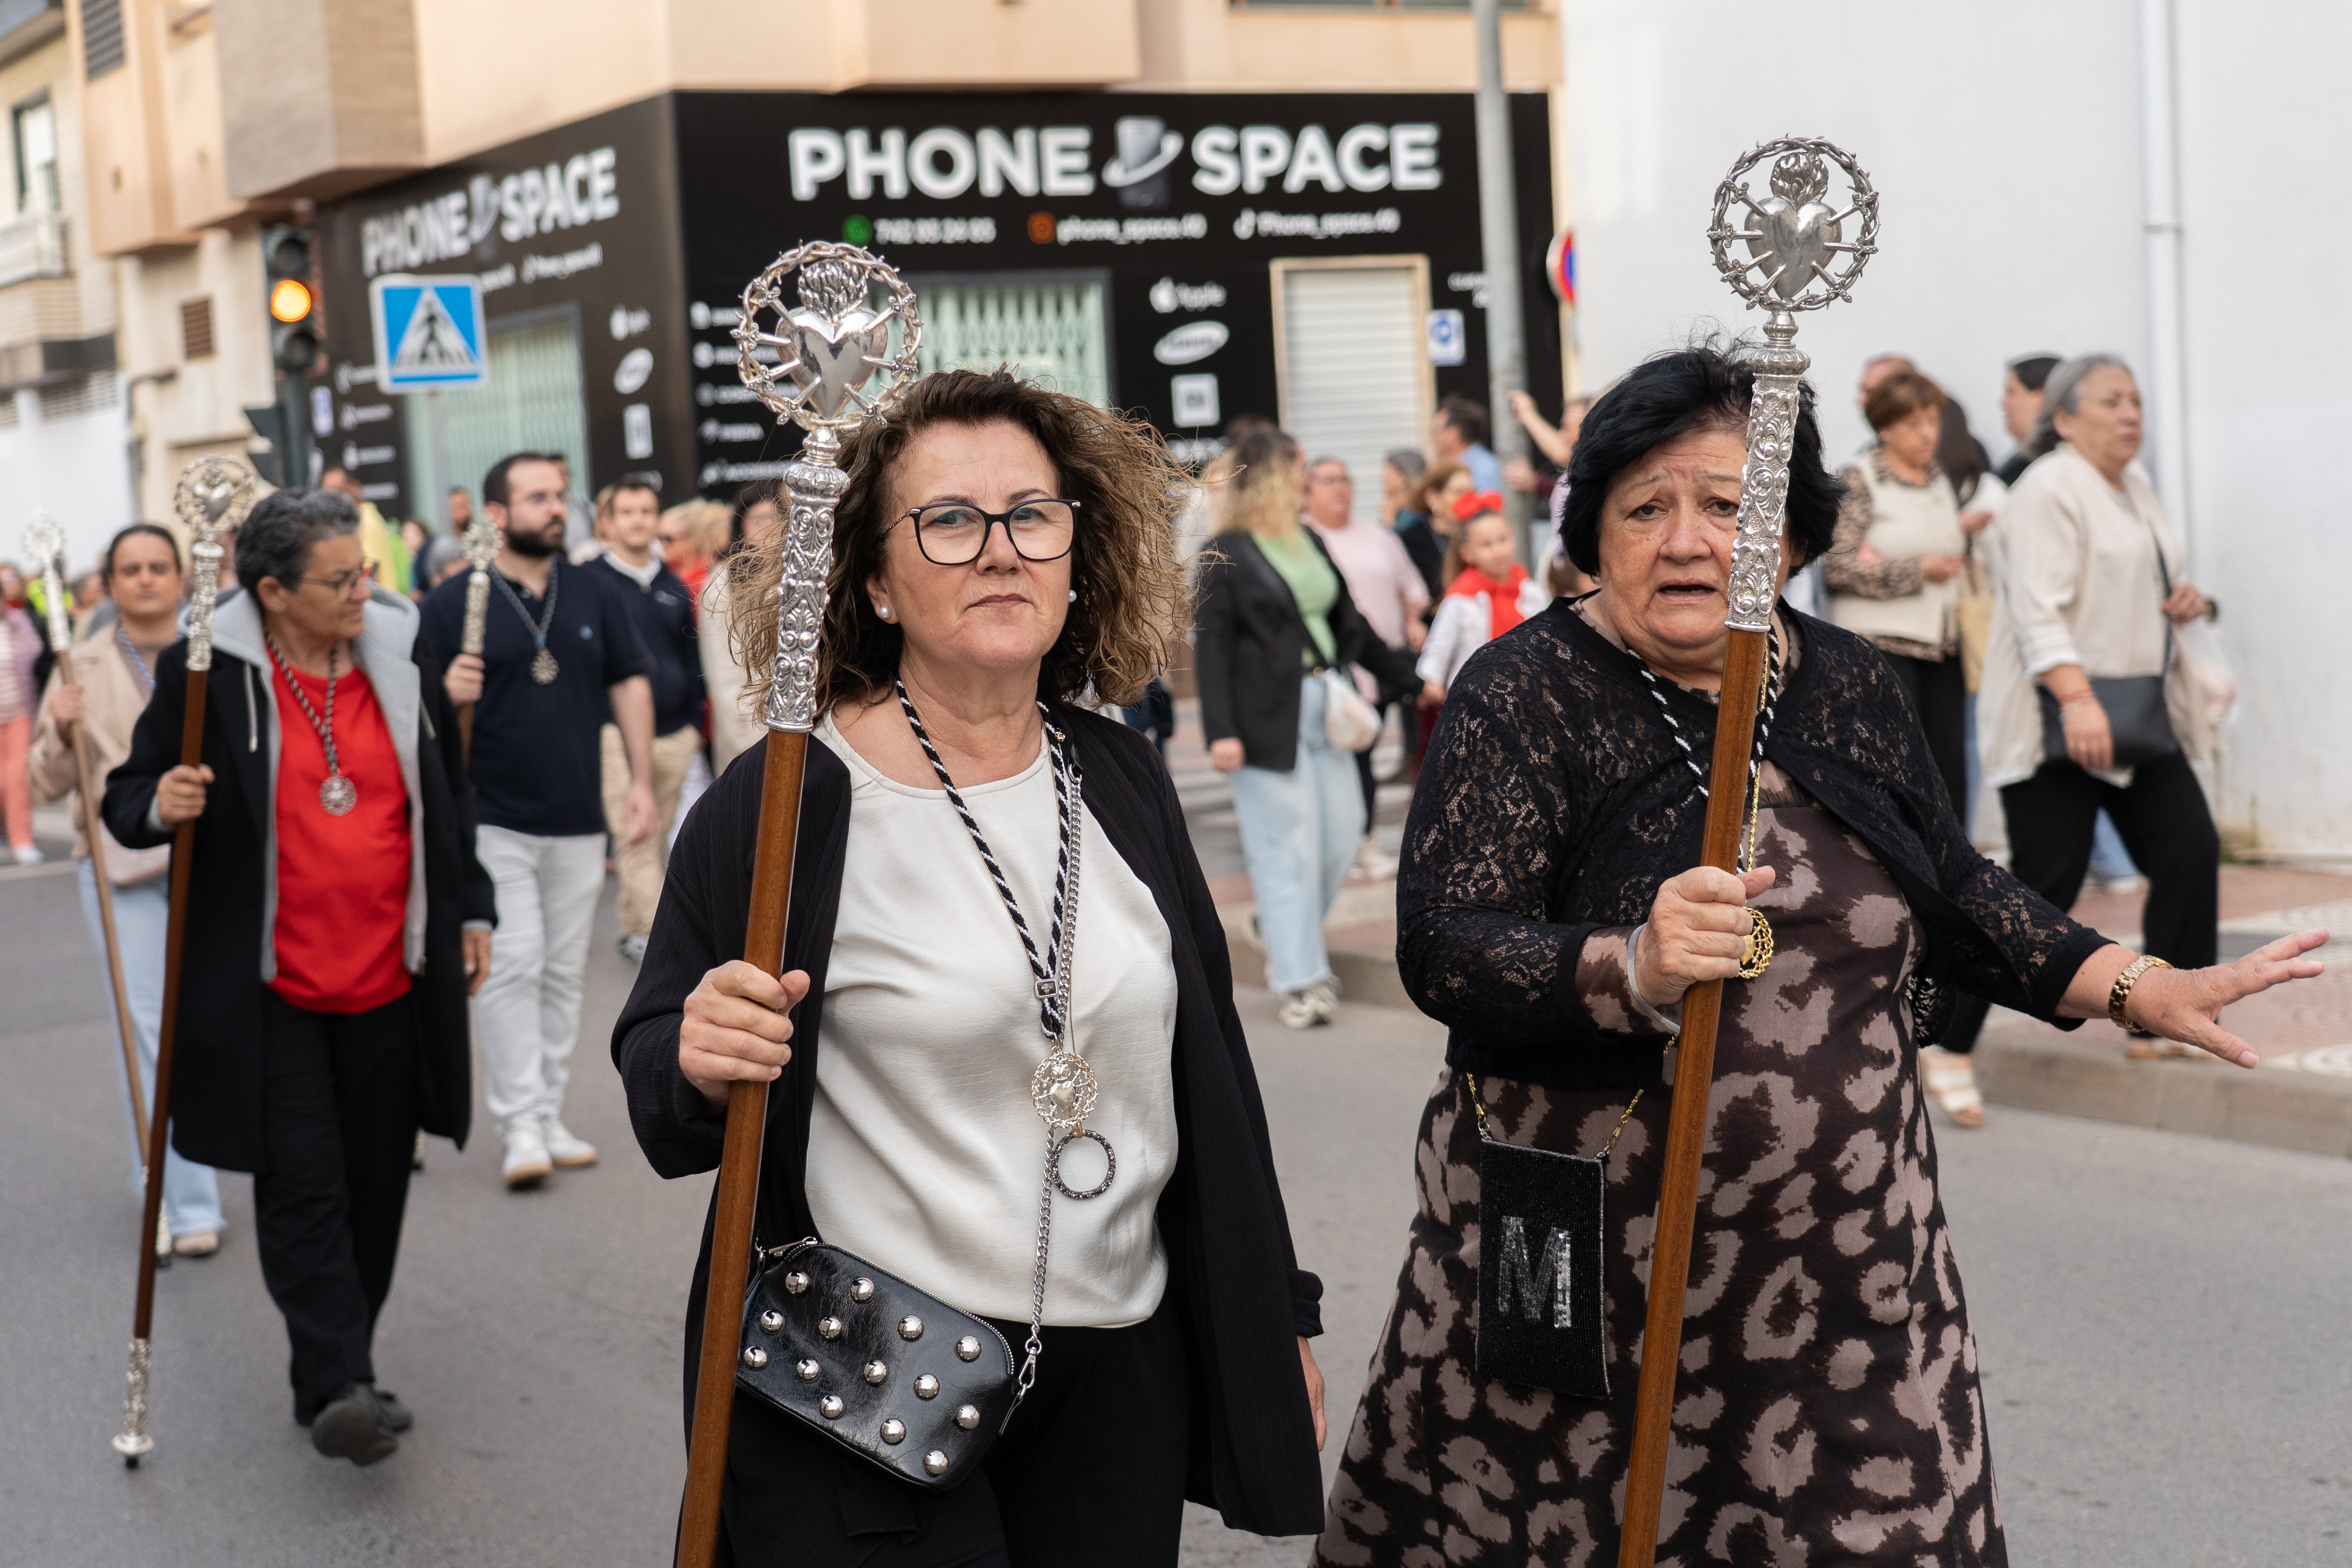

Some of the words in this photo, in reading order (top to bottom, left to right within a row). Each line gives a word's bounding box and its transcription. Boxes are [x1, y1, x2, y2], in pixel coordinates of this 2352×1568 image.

[361, 190, 471, 277] PHONE
[499, 146, 619, 242] SPACE
[788, 125, 1095, 201] PHONE
[1191, 122, 1443, 195] SPACE
[1498, 1215, 1571, 1328] M
